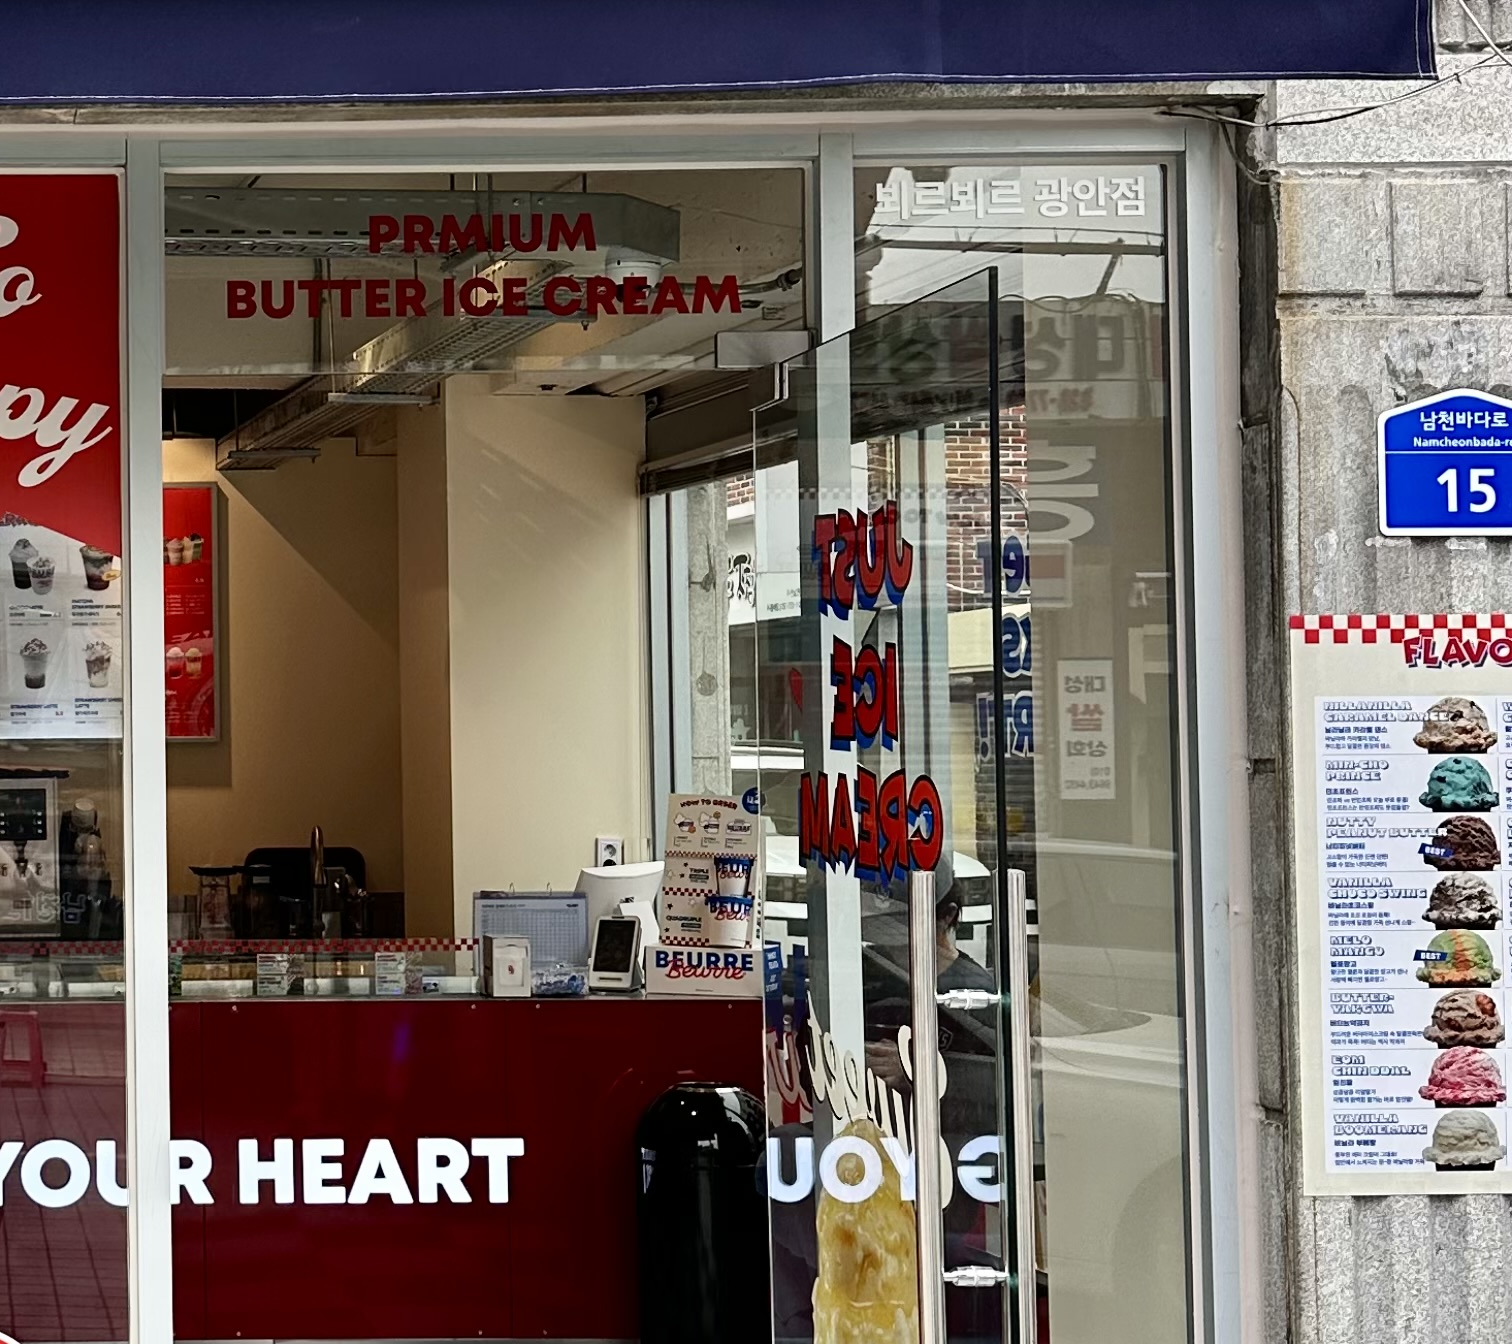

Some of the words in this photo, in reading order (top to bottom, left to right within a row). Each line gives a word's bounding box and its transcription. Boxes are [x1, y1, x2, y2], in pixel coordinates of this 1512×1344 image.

[1034, 176, 1146, 219] 광안점
[369, 212, 596, 253] PRMIUM
[227, 279, 427, 320] BUTTER
[443, 277, 530, 317] ICE
[543, 275, 741, 316] CREAM
[1420, 411, 1509, 431] 남천바다로
[1437, 468, 1497, 513] 15
[1402, 633, 1512, 669] FLAVO
[1326, 771, 1381, 782] PRINCE
[1326, 827, 1387, 838] PEANUT
[1327, 877, 1393, 887] VANILLA
[1330, 935, 1372, 945] MELO
[656, 950, 753, 972] BEURRE
[238, 1138, 525, 1205] HEART
